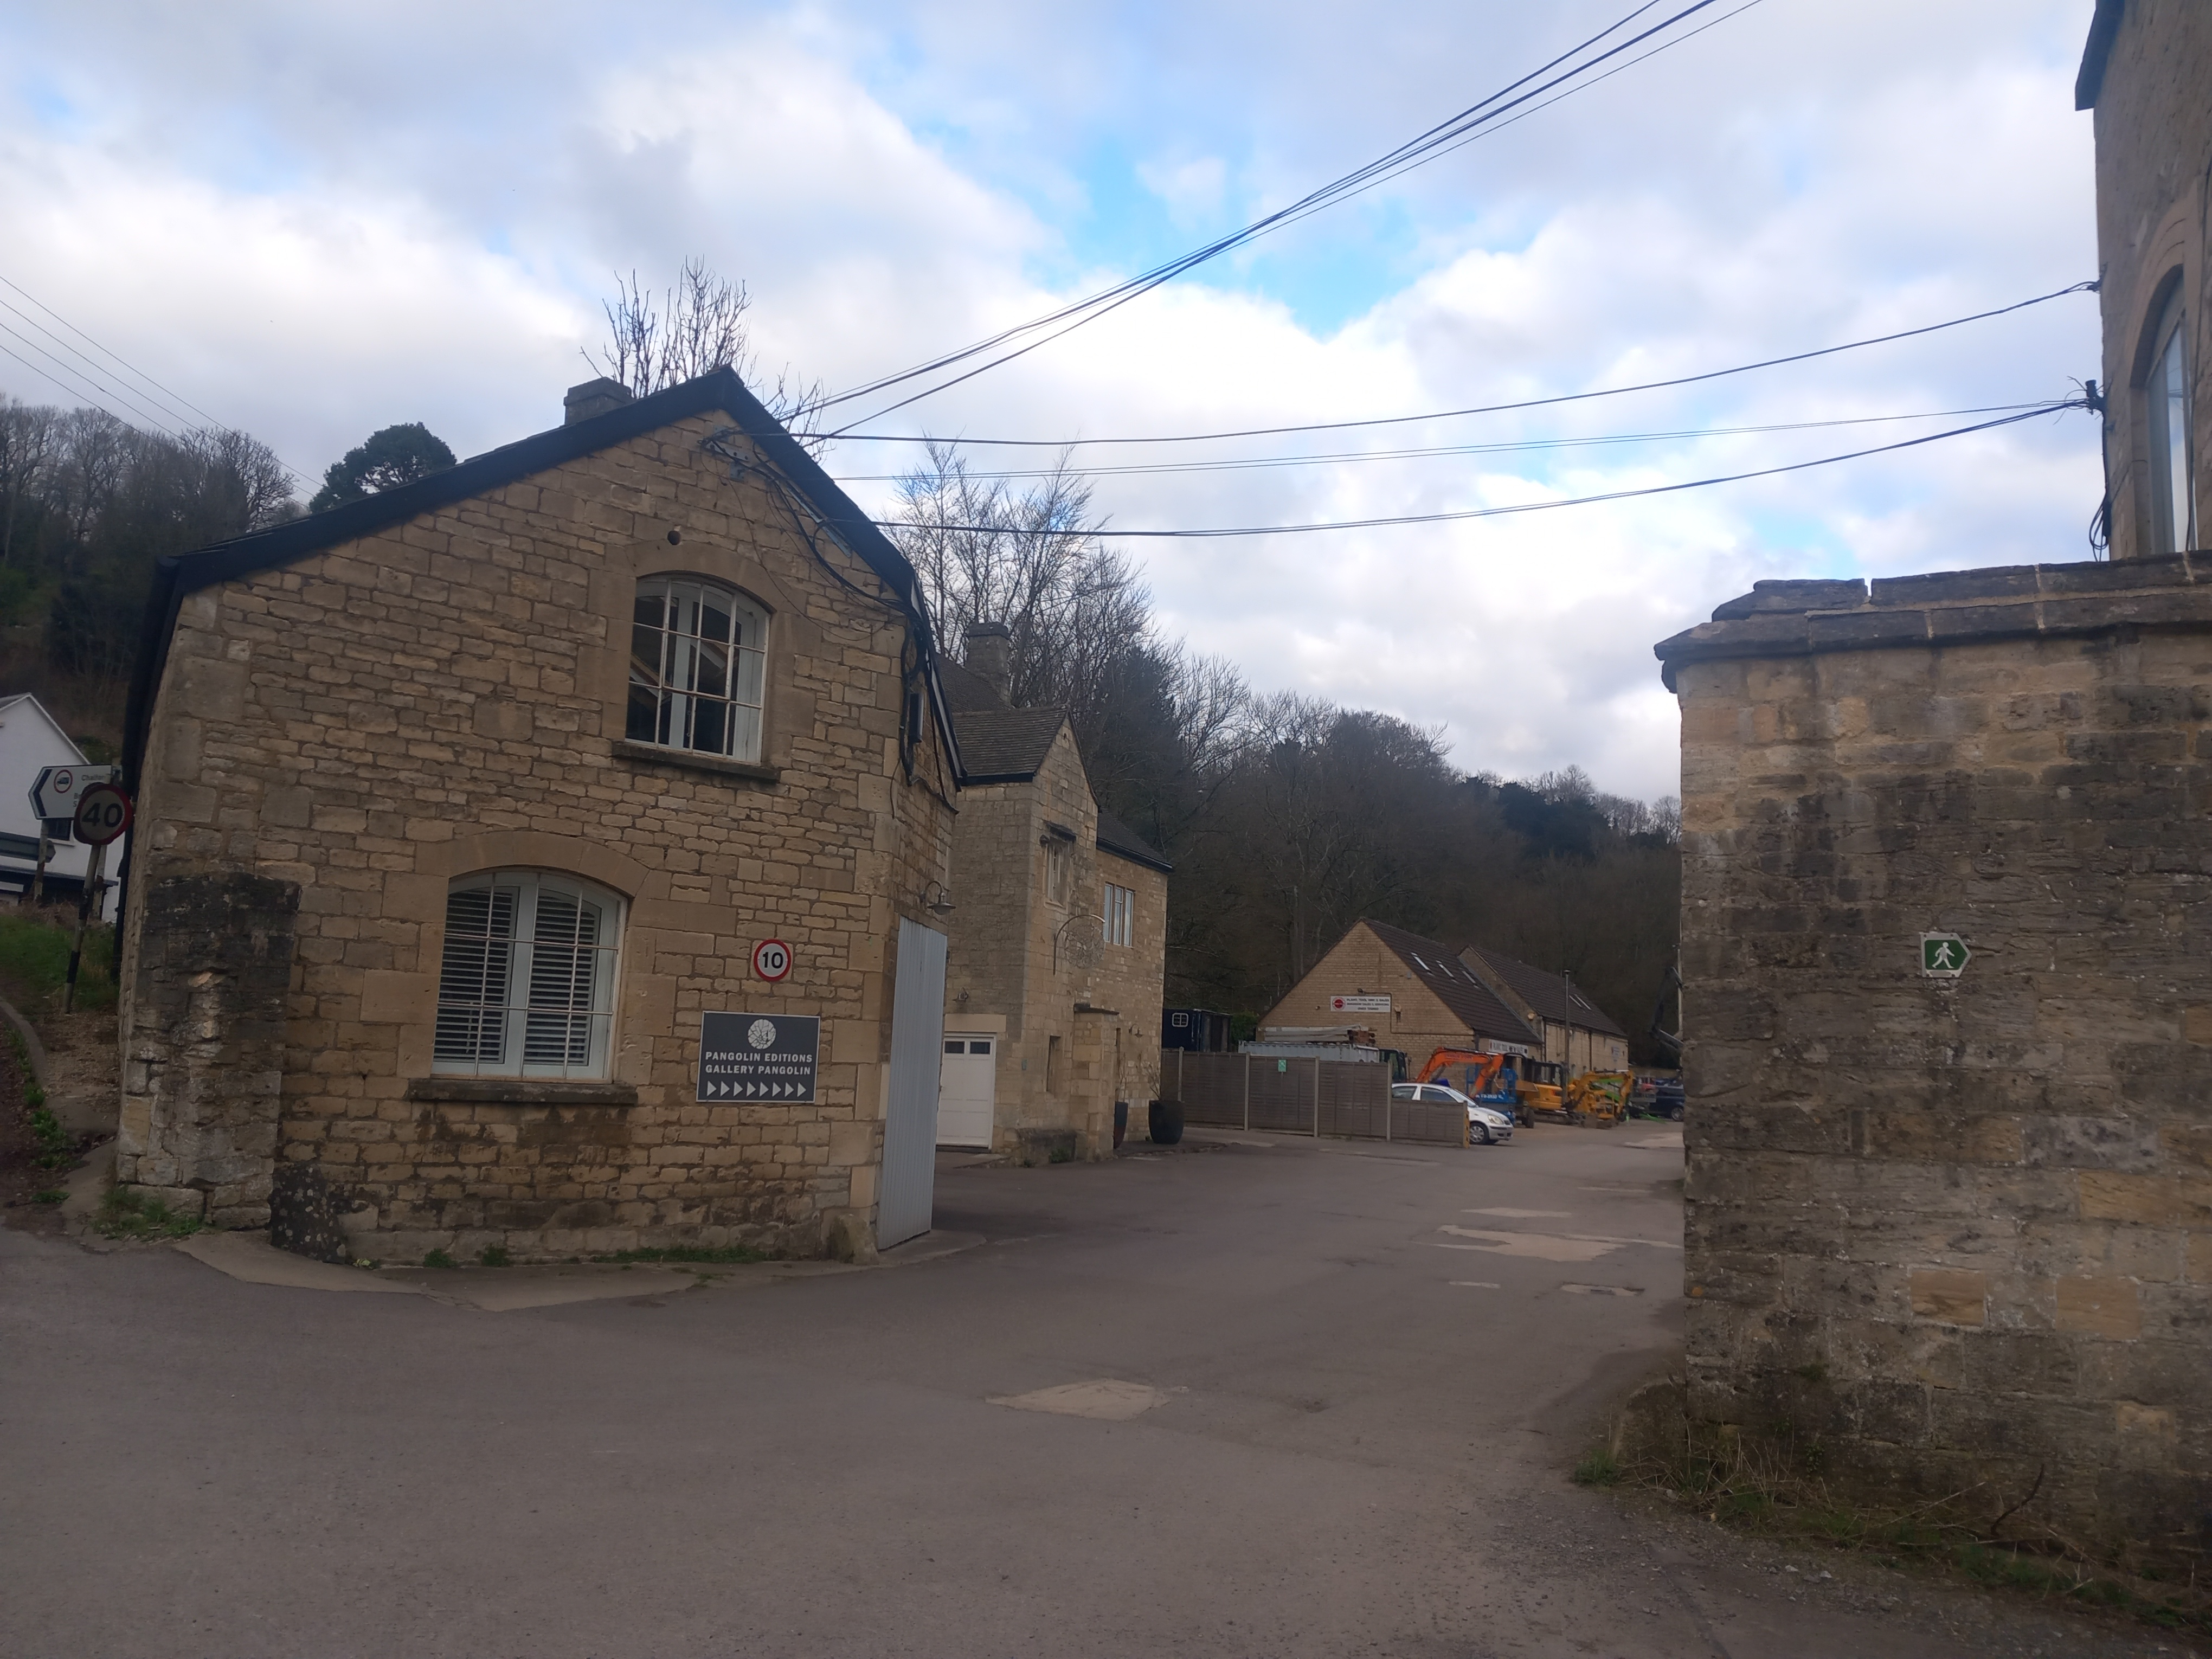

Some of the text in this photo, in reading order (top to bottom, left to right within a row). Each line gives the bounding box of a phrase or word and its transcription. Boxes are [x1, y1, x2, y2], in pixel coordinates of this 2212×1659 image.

[81, 802, 123, 827] 40
[762, 951, 784, 969] 10
[705, 1051, 813, 1063] PANGOLIN EDITIONS
[705, 1064, 811, 1075] GALLERY PANGOLIN
